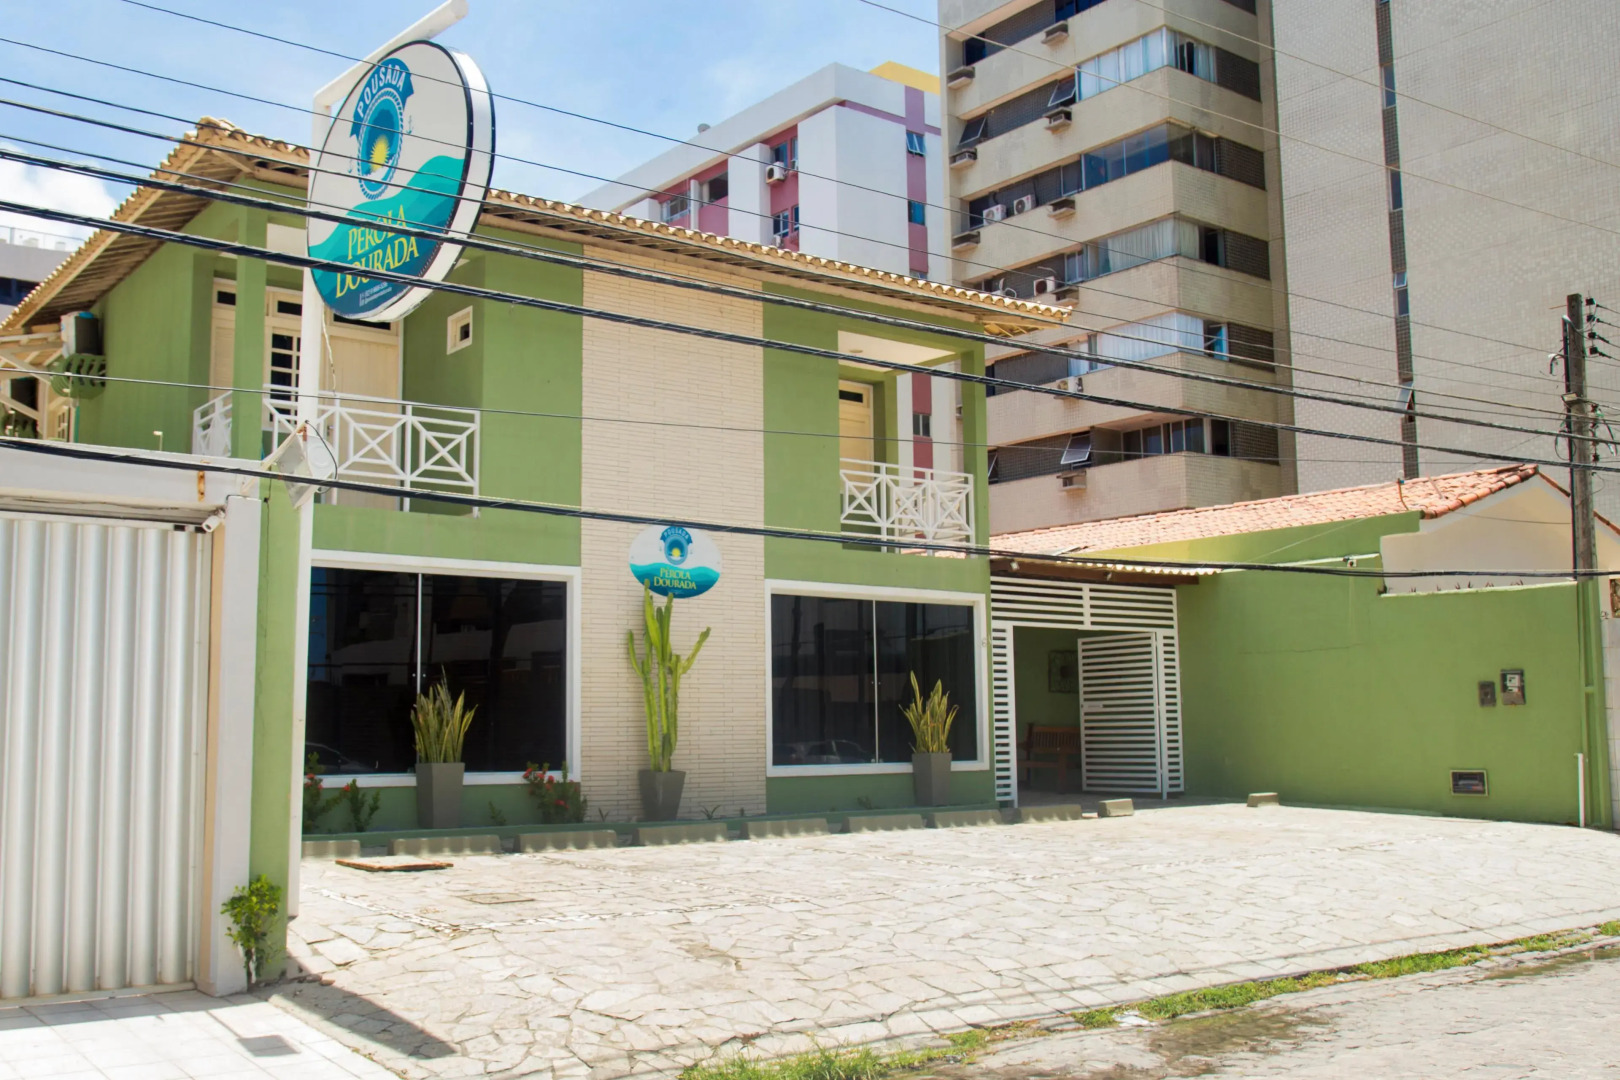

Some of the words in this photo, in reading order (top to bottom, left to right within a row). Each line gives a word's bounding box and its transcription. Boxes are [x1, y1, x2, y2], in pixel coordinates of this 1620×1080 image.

[357, 64, 406, 118] POUSADA
[663, 526, 689, 539] POUSADA
[654, 576, 696, 590] DOURADA
